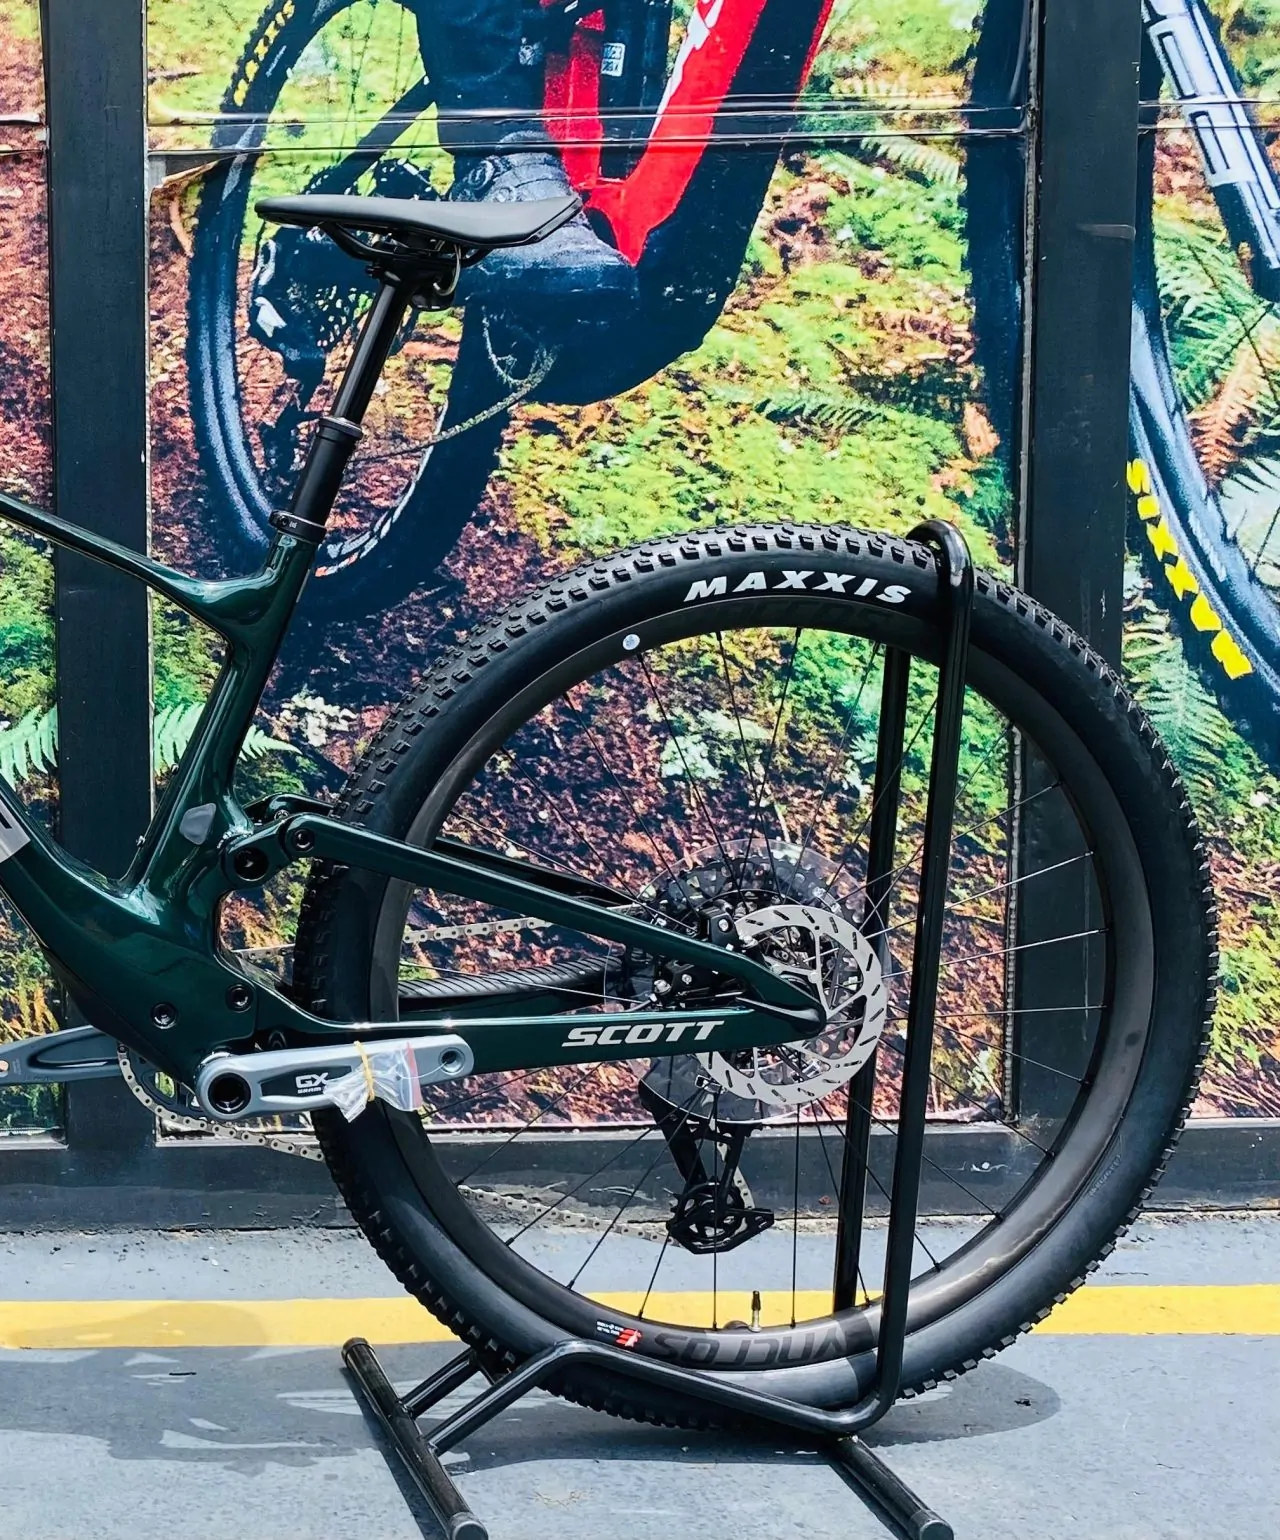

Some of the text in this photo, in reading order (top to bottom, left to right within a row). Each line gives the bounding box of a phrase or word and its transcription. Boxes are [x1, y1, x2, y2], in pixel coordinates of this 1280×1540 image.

[683, 570, 912, 604] MAXXIS
[561, 1020, 725, 1048] SCOTT
[295, 1072, 329, 1089] GX
